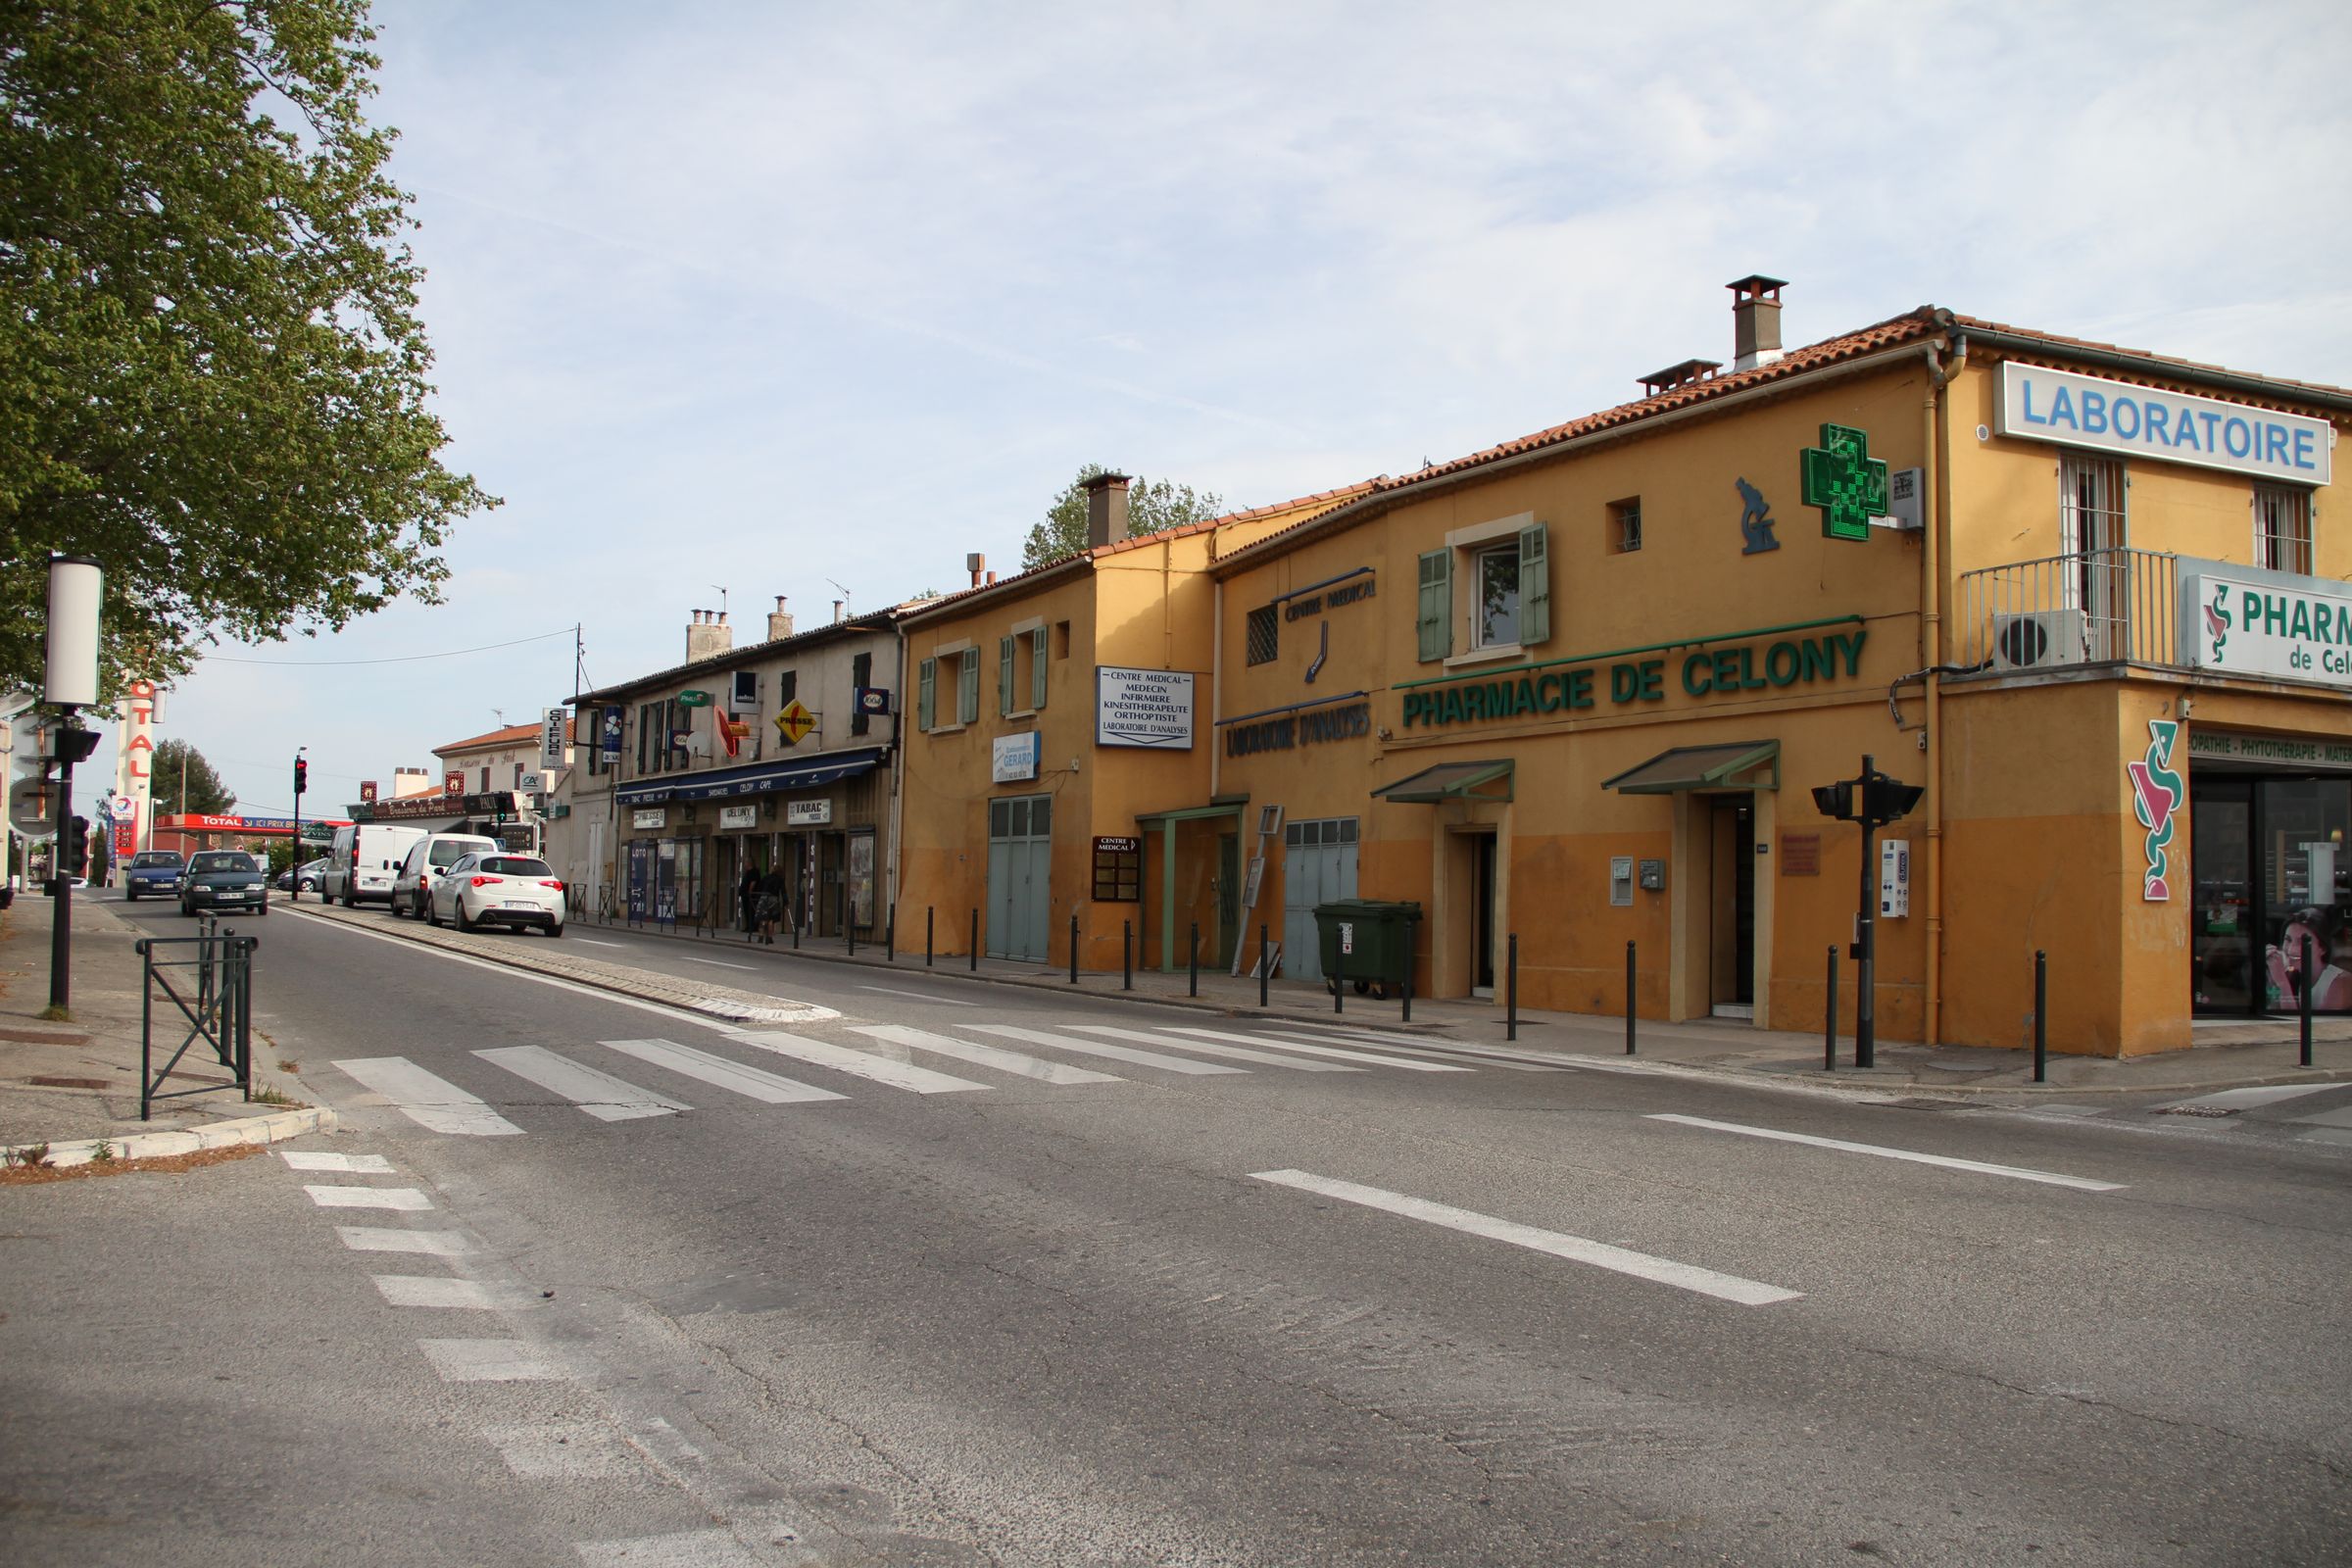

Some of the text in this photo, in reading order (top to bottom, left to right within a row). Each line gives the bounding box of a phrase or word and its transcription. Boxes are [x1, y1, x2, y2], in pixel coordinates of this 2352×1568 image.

[2022, 379, 2316, 469] LABORATOIRE
[1285, 579, 1376, 622] CENTRE MEDICAL
[2289, 644, 2352, 674] de Cel
[1110, 671, 1182, 684] CENTRE MEDICAL
[1402, 630, 1867, 727] PHARMACIE DE CELONY
[1125, 684, 1167, 693] MEDECIN
[1121, 693, 1170, 703] INFIRMIERE
[1103, 701, 1189, 713] KINESITHERAPEUTE
[1114, 711, 1177, 722] ORTHOPTISTE
[548, 710, 562, 756] COIFFURE
[1103, 721, 1188, 734] LABORATOIRE D'ANALYSES
[1227, 702, 1370, 759] LABORATOIRE D'ANALYSES
[2188, 735, 2230, 754] OPATHIE
[1004, 752, 1033, 767] GERARD
[389, 803, 417, 815] Brasserie
[418, 804, 426, 812] du
[428, 802, 445, 812] Park
[796, 802, 822, 813] TABAC
[202, 815, 242, 826] TOTAL
[268, 819, 284, 828] PRIX
[632, 849, 646, 858] LOTO
